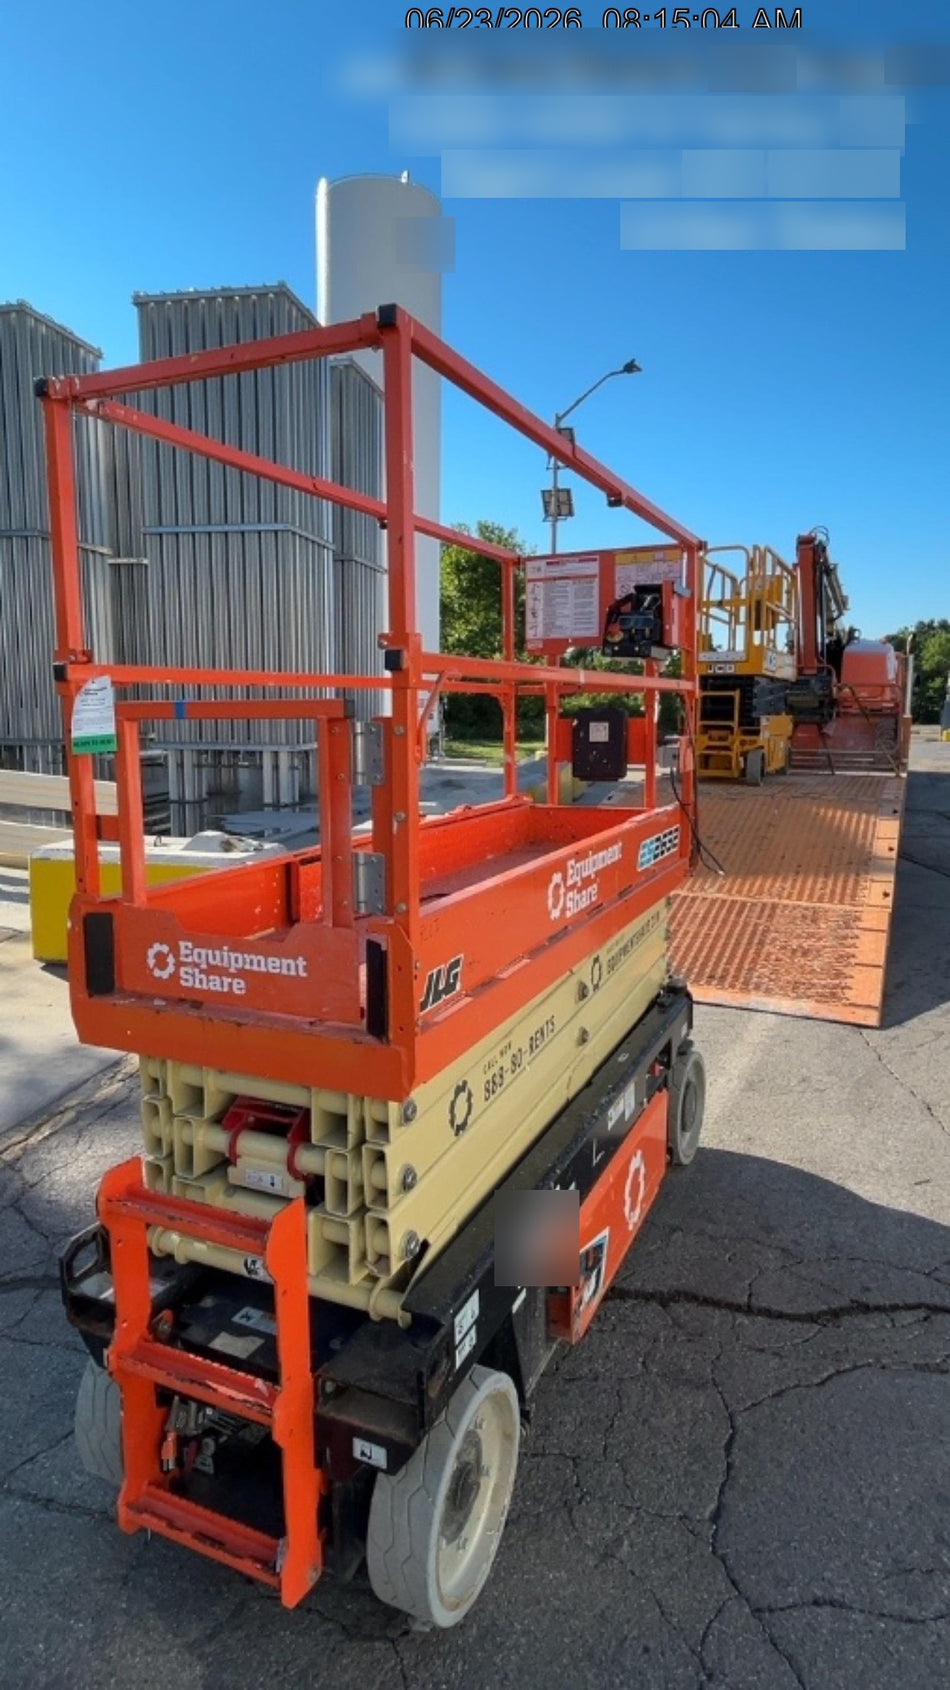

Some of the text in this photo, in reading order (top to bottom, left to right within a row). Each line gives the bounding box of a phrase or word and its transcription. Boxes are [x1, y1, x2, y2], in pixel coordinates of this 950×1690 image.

[566, 841, 622, 887] Equipment
[566, 883, 598, 918] Share
[178, 940, 308, 977] Equipment
[179, 967, 246, 995] Share
[420, 954, 464, 1012] JLG
